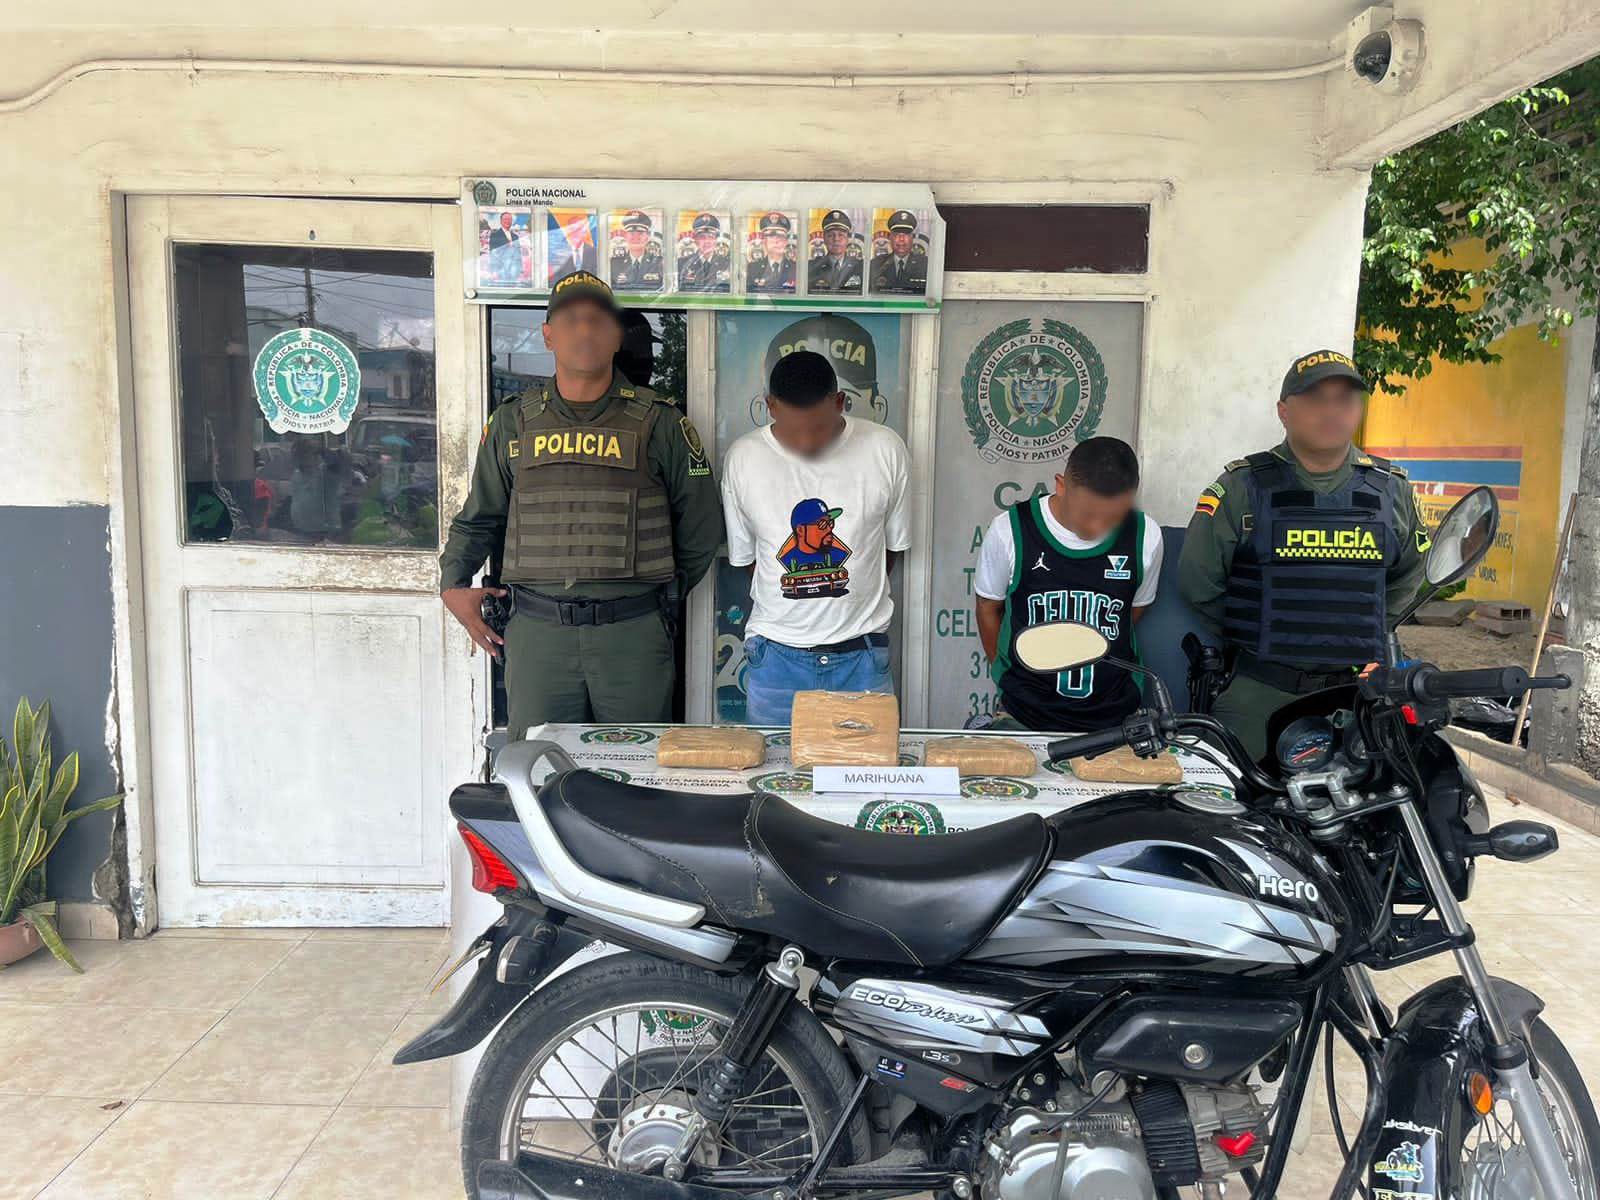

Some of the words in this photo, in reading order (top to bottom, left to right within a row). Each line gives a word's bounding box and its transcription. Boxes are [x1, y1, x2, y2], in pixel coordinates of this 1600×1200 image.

[542, 189, 586, 198] NACIONAL
[778, 338, 866, 367] POICIA
[320, 346, 347, 387] COLOMBIA
[1029, 334, 1046, 344] DE
[1057, 341, 1089, 400] COLOMBIA
[309, 396, 343, 419] NACIONAL
[309, 418, 336, 430] PATRIA
[1032, 413, 1084, 447] NACIONAL
[533, 432, 622, 459] POLICIA
[1031, 443, 1070, 461] PATRIA
[1286, 526, 1377, 548] POLICÍA
[844, 773, 925, 784] MARIHUANA
[1258, 875, 1319, 902] Hero
[849, 987, 906, 1009] ECO
